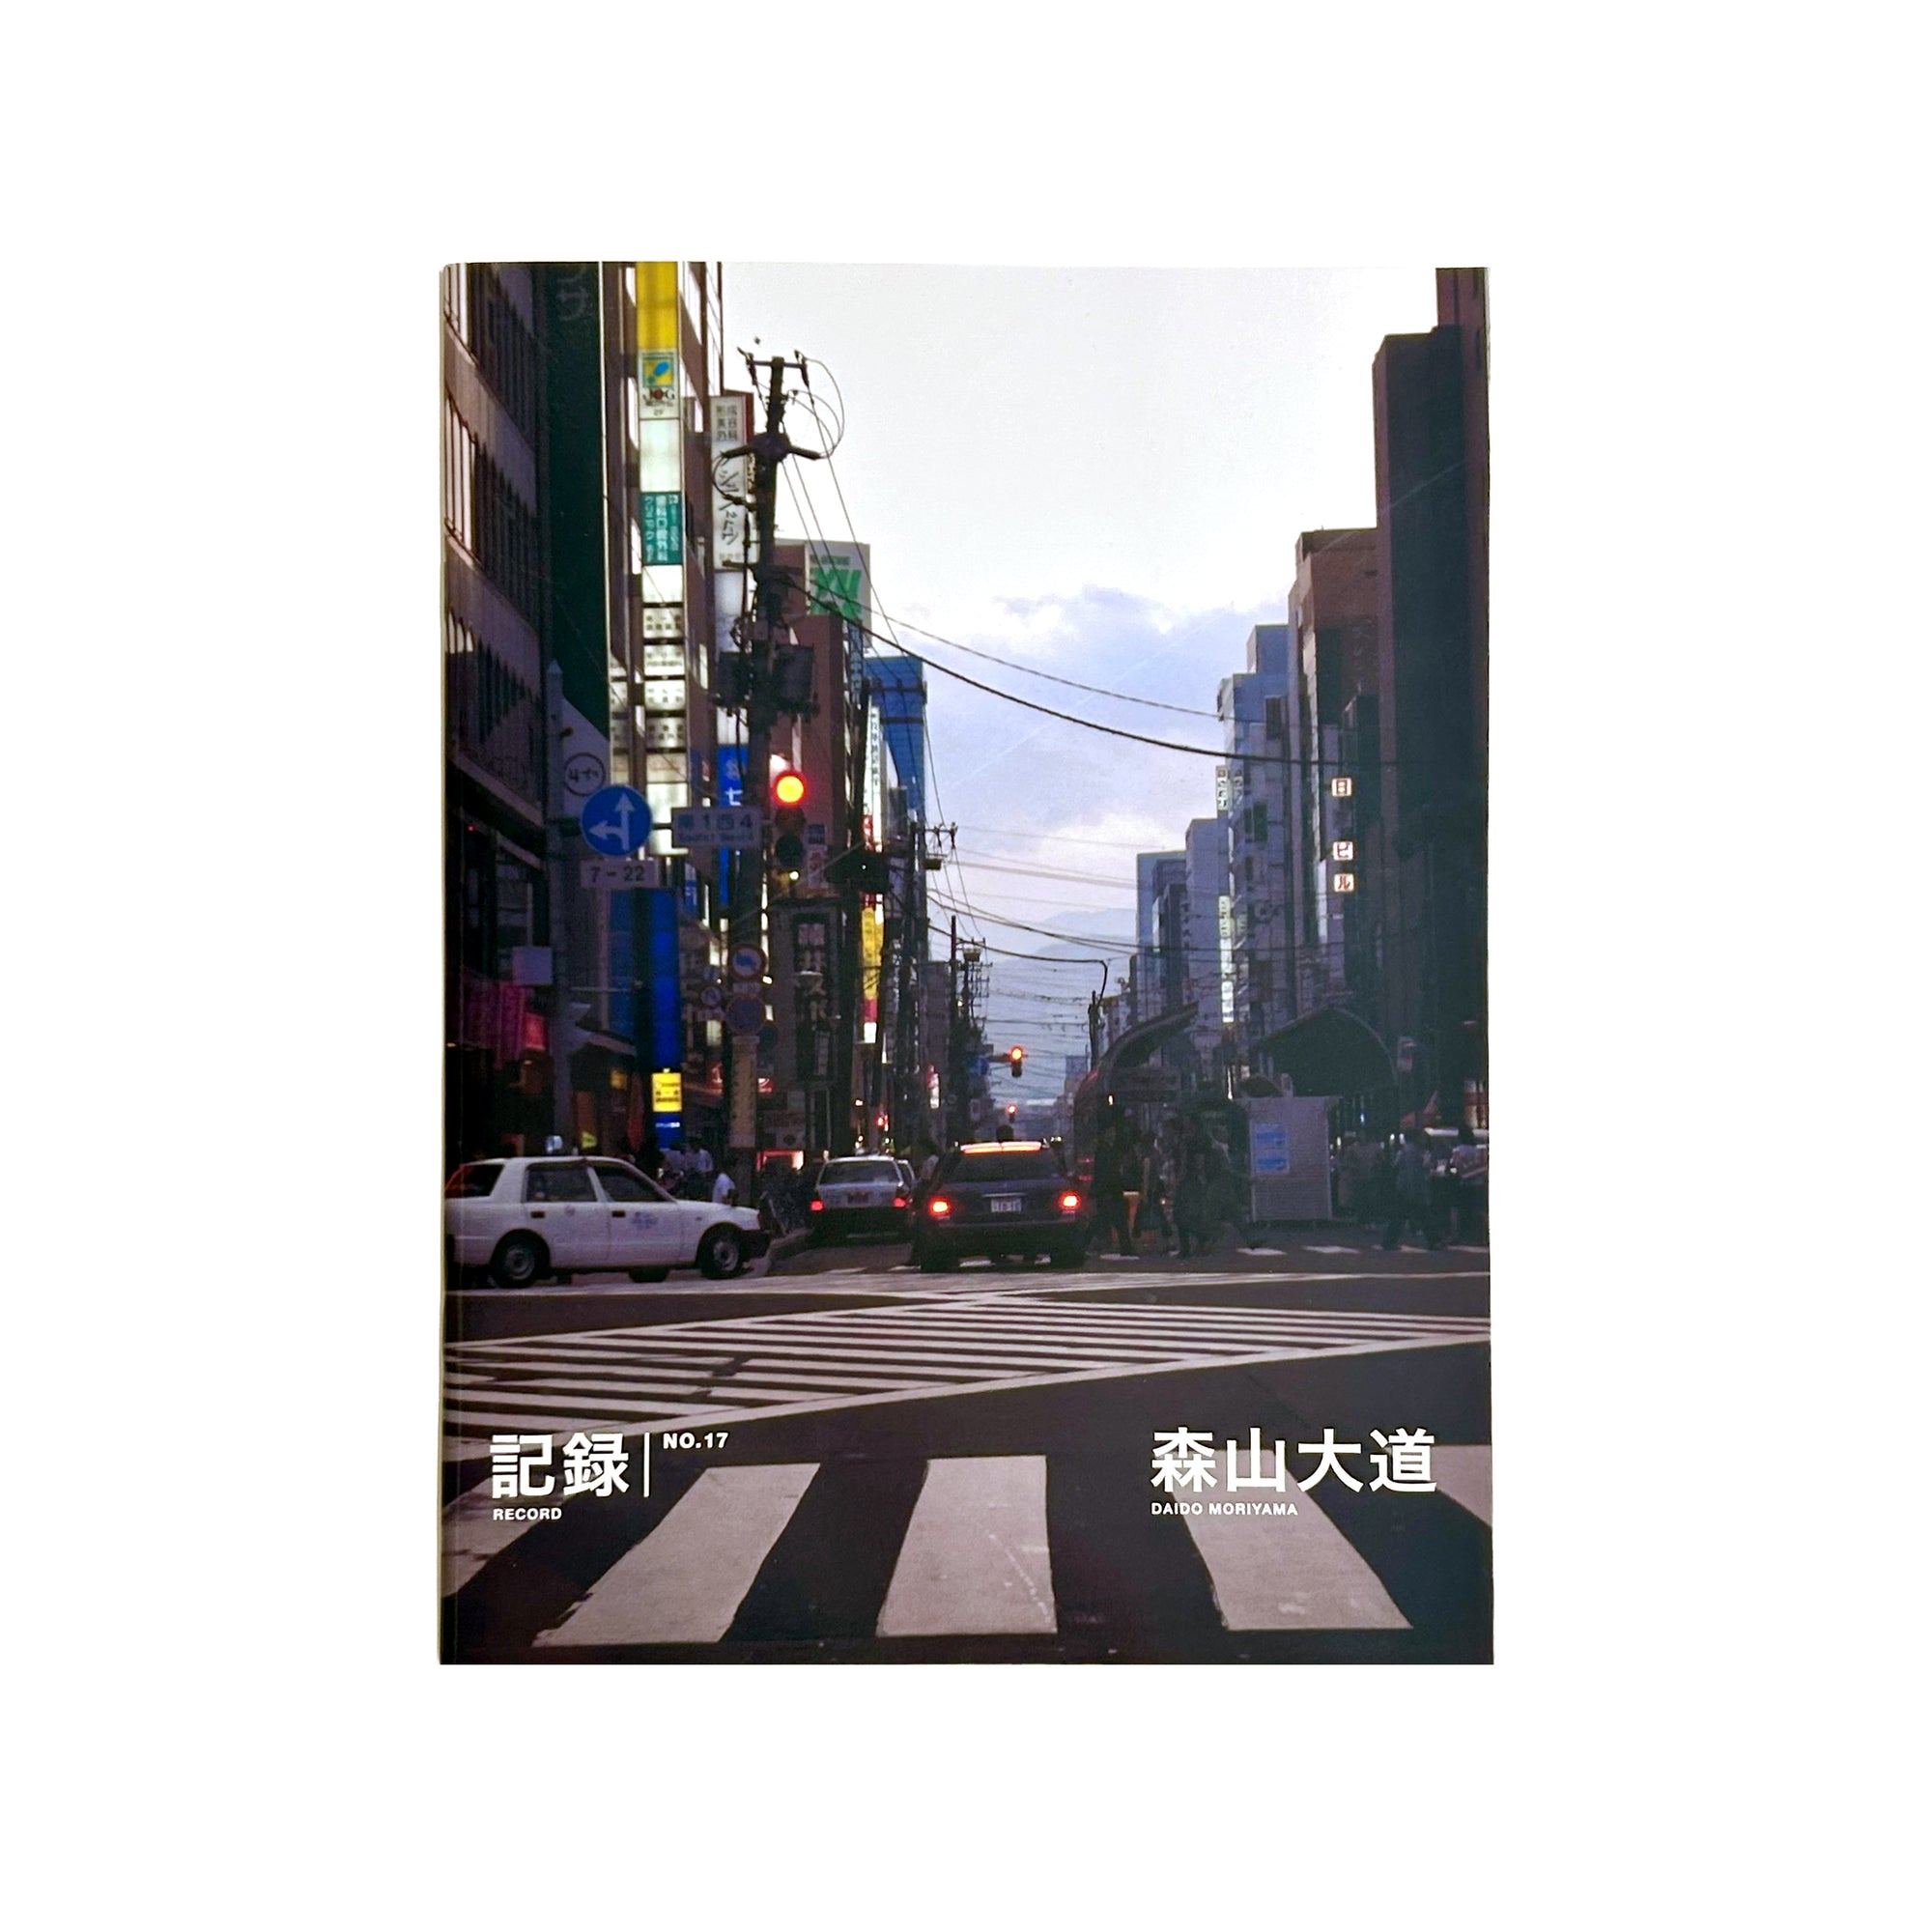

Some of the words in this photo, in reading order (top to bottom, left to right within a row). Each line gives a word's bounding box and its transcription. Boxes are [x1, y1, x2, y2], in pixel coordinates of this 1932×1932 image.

[663, 1433, 729, 1449] NO.17
[490, 1432, 630, 1498] 記録
[1151, 1426, 1437, 1493] 森山大道
[493, 1507, 562, 1520] RECORD
[1151, 1502, 1204, 1516] DAIDO
[1208, 1502, 1298, 1516] MORIYAMA
